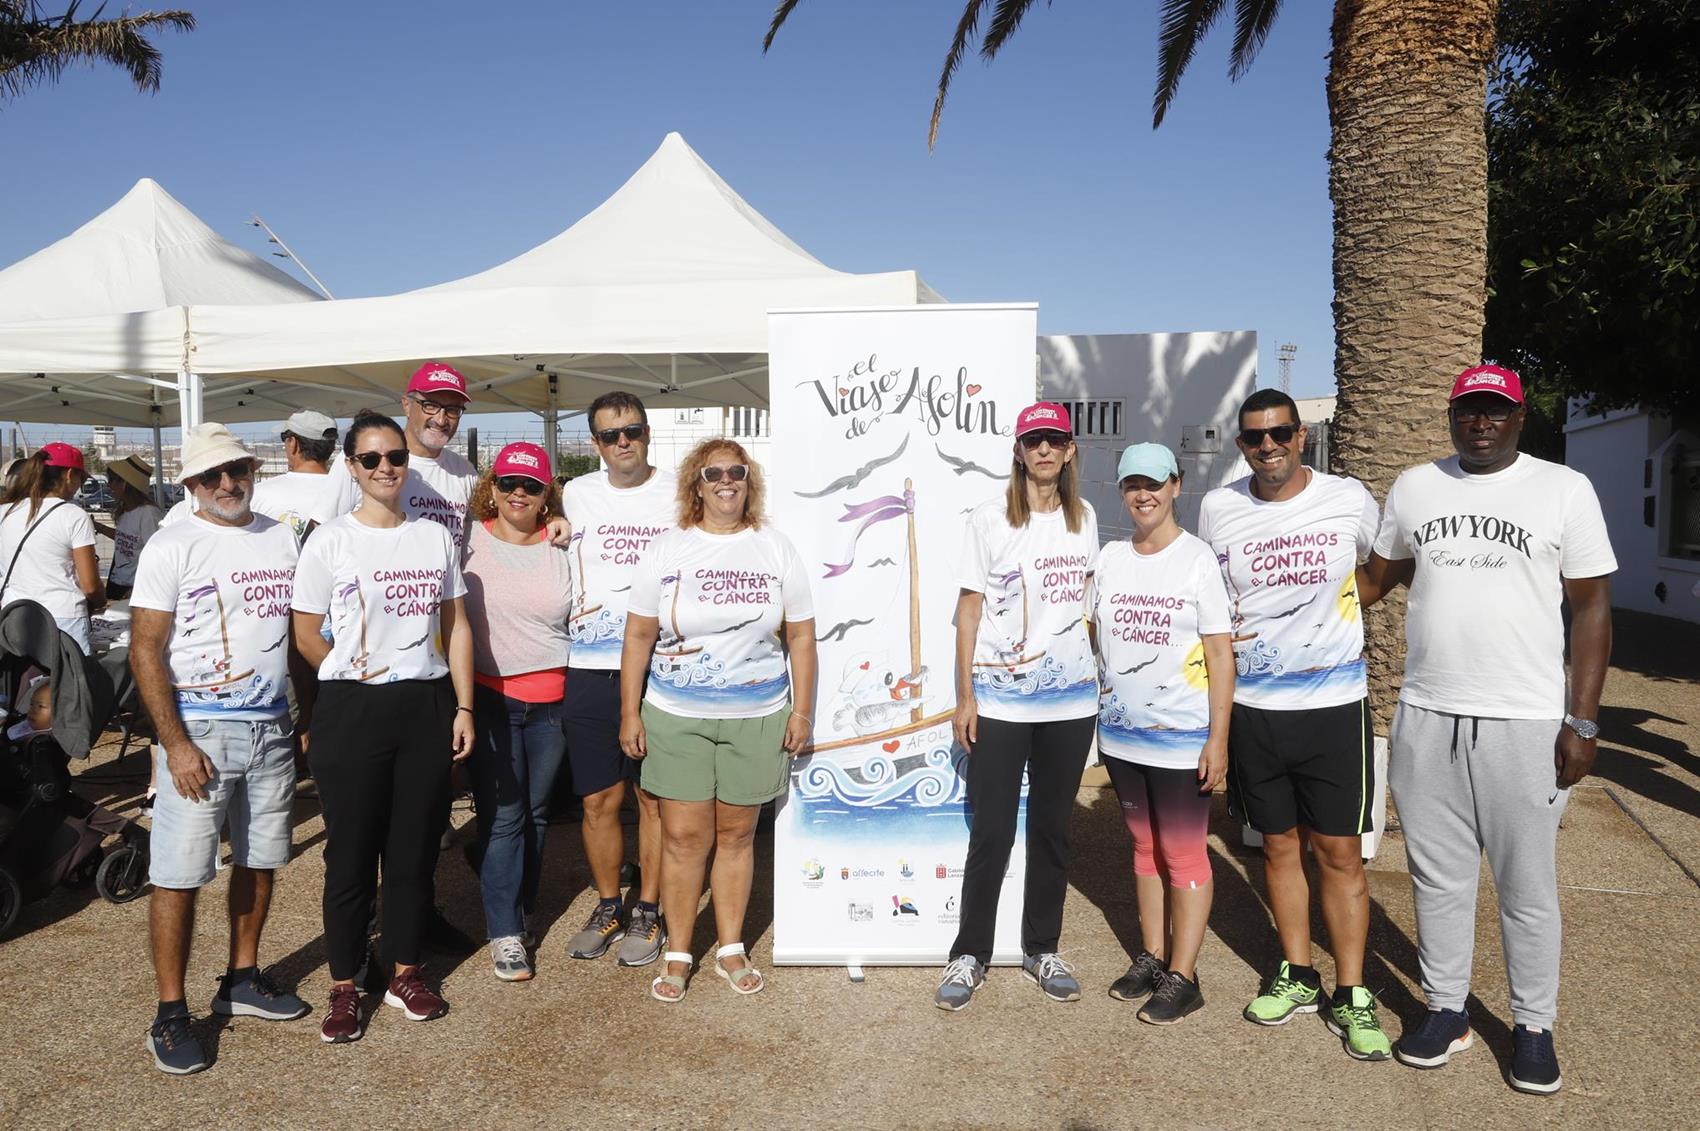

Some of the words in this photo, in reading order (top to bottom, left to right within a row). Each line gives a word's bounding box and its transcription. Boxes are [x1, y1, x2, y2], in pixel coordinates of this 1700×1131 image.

[847, 353, 877, 381] el
[845, 411, 884, 440] de
[409, 496, 467, 514] CAMINAMO
[419, 512, 464, 529] ONTR
[1243, 533, 1338, 555] CAMINAMOS
[1413, 515, 1467, 553] NEW
[1468, 515, 1533, 560] YORK
[600, 553, 612, 561] EL
[1035, 555, 1088, 570] CAMINAMO
[1251, 550, 1326, 573] CONTRA
[1428, 550, 1466, 568] East
[1469, 552, 1509, 572] Side
[702, 578, 768, 591] CONTRA
[1251, 577, 1263, 587] EL
[698, 594, 710, 602] EL
[1040, 592, 1048, 602] EL
[1110, 593, 1185, 610] CAMINAMOS
[243, 607, 254, 616] EL
[384, 605, 394, 614] EL
[1114, 609, 1171, 628] CONTRA
[1111, 628, 1121, 636] EL
[907, 730, 948, 750] AFOL
